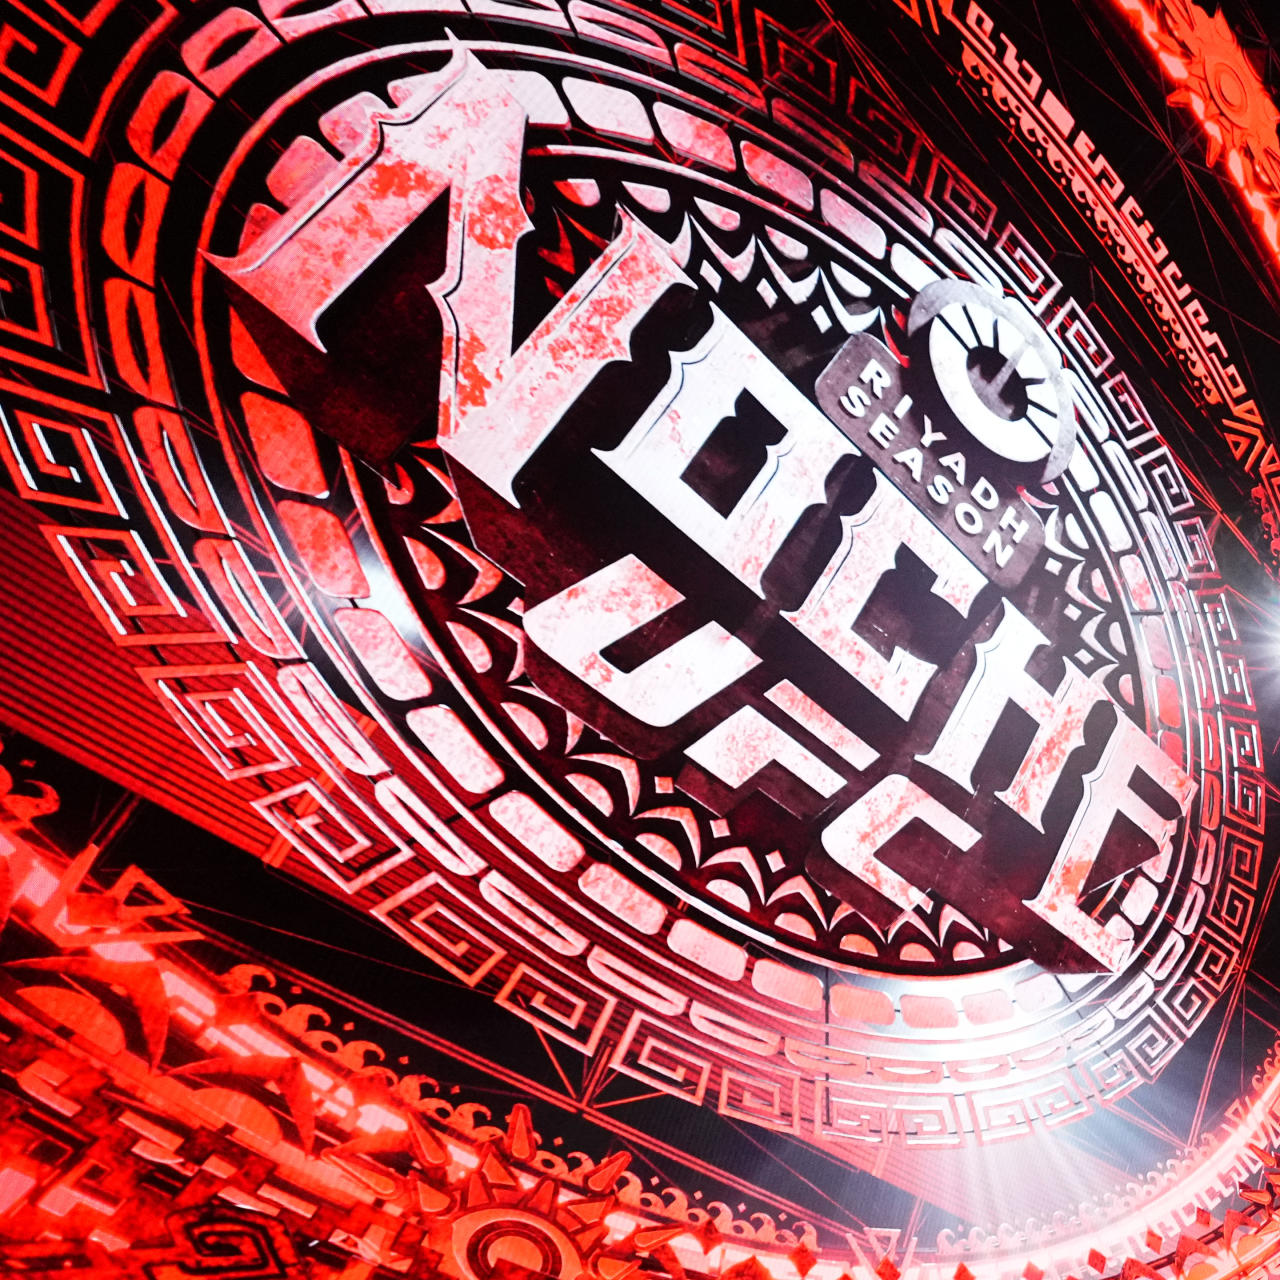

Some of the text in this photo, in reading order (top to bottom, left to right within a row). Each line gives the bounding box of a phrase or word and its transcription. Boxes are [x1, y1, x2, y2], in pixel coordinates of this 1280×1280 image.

[198, 26, 1200, 973] NOCHE
[840, 385, 1015, 568] SEASON
[859, 358, 1029, 544] RIYADH
[523, 553, 982, 913] UFC
